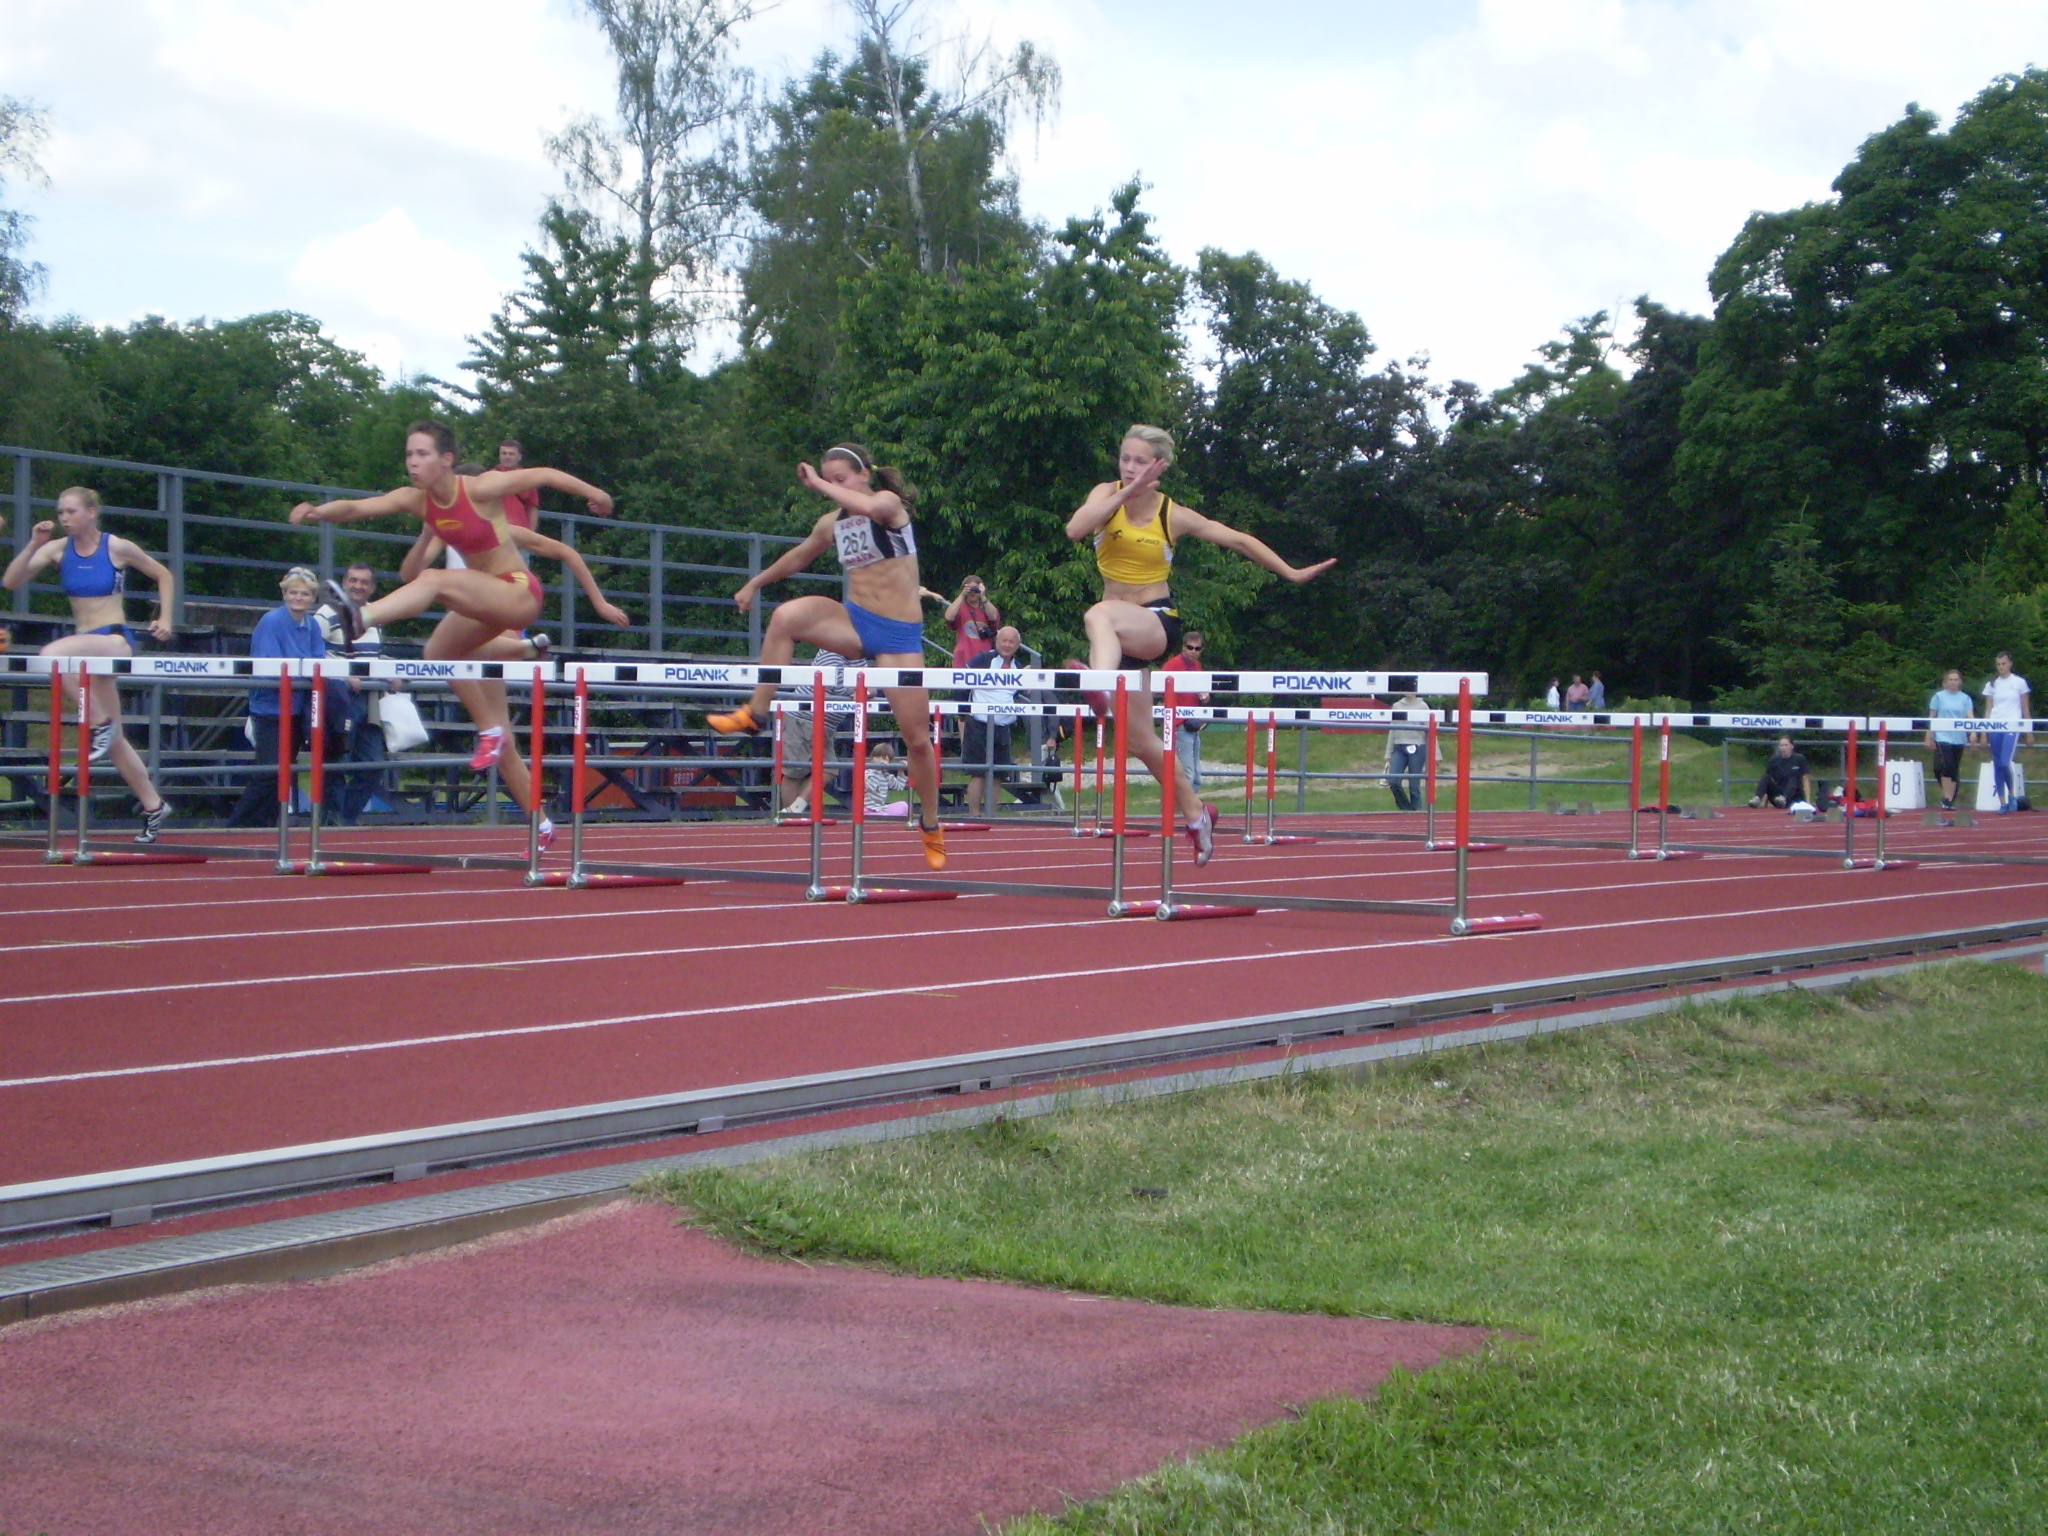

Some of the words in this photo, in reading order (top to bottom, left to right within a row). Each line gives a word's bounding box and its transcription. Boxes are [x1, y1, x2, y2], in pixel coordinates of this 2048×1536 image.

[842, 530, 868, 556] 262
[154, 660, 208, 673] POLANIK
[395, 663, 455, 676] POLANIK
[665, 667, 729, 681] POLANIK
[952, 672, 1023, 686] POLANIK
[1272, 675, 1352, 690] POLANIK
[987, 705, 1025, 714] POLANIK
[1329, 711, 1372, 720] POLANIK
[1526, 713, 1573, 723] POLANIK
[1732, 716, 1783, 727] POLANIK
[1954, 721, 2008, 730] POLANIK
[1892, 772, 1901, 796] 8
